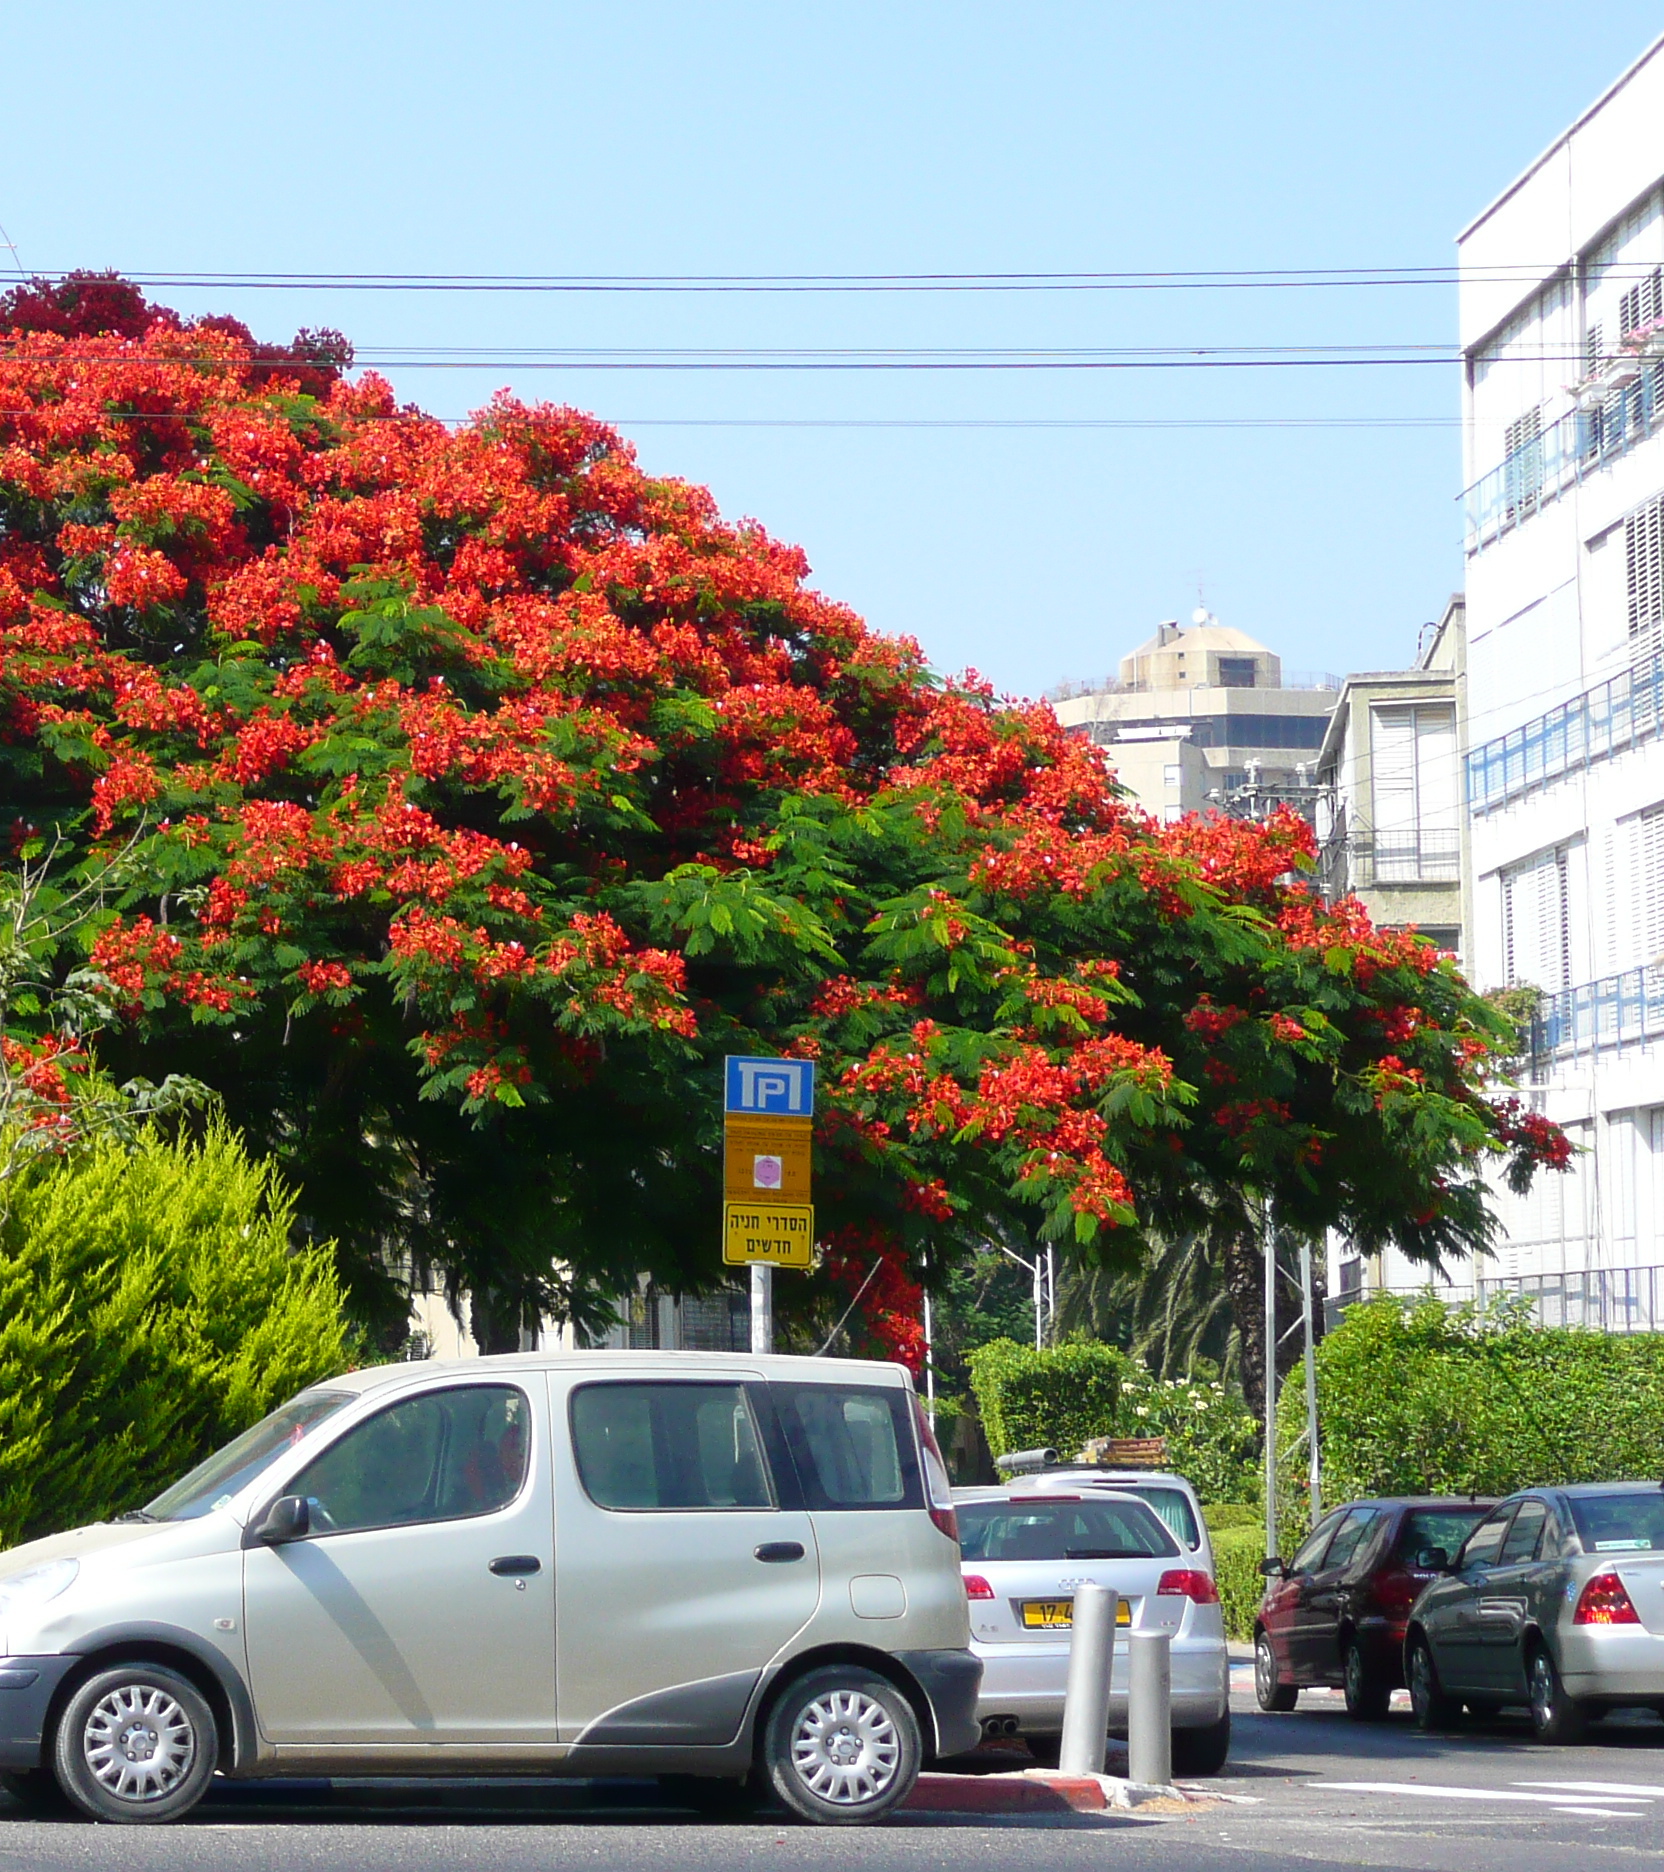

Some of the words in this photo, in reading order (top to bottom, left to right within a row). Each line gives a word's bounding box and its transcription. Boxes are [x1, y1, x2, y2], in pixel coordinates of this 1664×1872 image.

[730, 1214, 760, 1230] חניה
[766, 1216, 807, 1232] הסדרי
[746, 1238, 791, 1254] חדשים
